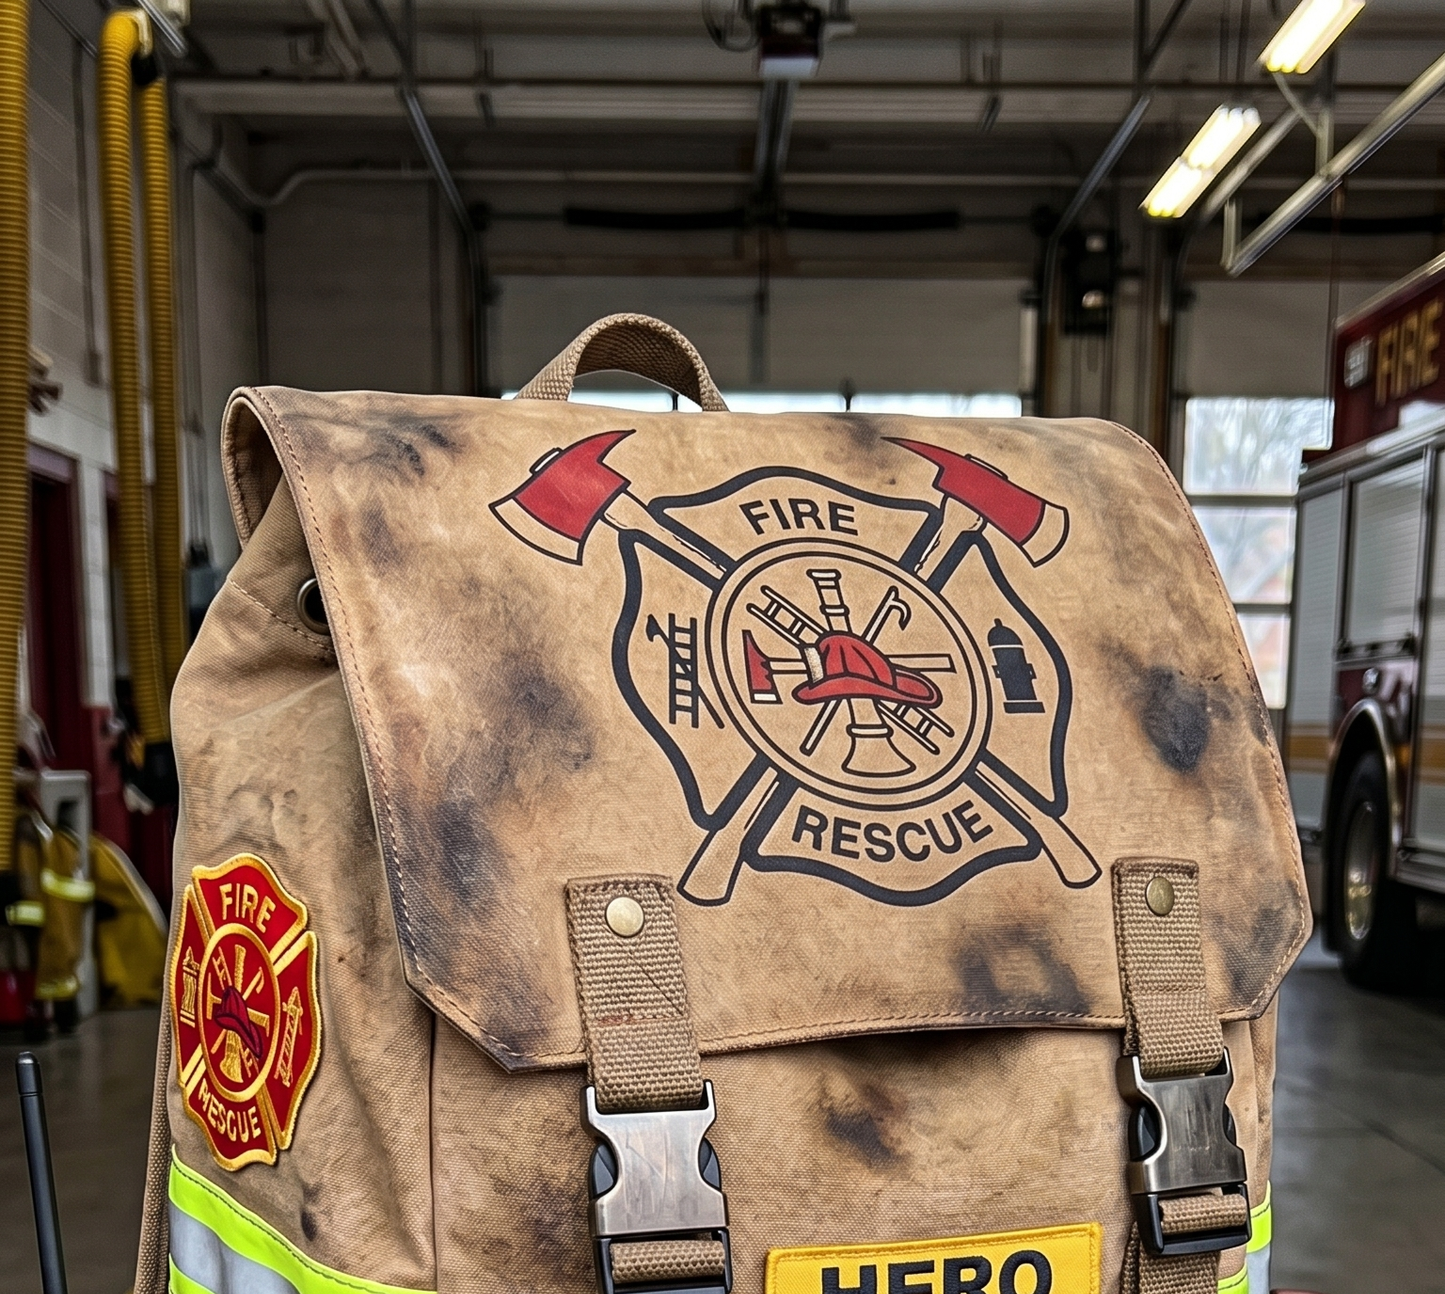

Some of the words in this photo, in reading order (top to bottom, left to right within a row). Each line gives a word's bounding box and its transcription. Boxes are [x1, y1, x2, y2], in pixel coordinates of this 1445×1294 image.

[1376, 299, 1443, 405] FIRE
[739, 498, 859, 536] FIRE
[791, 800, 994, 863] RESCUE
[219, 882, 276, 933] FIRE
